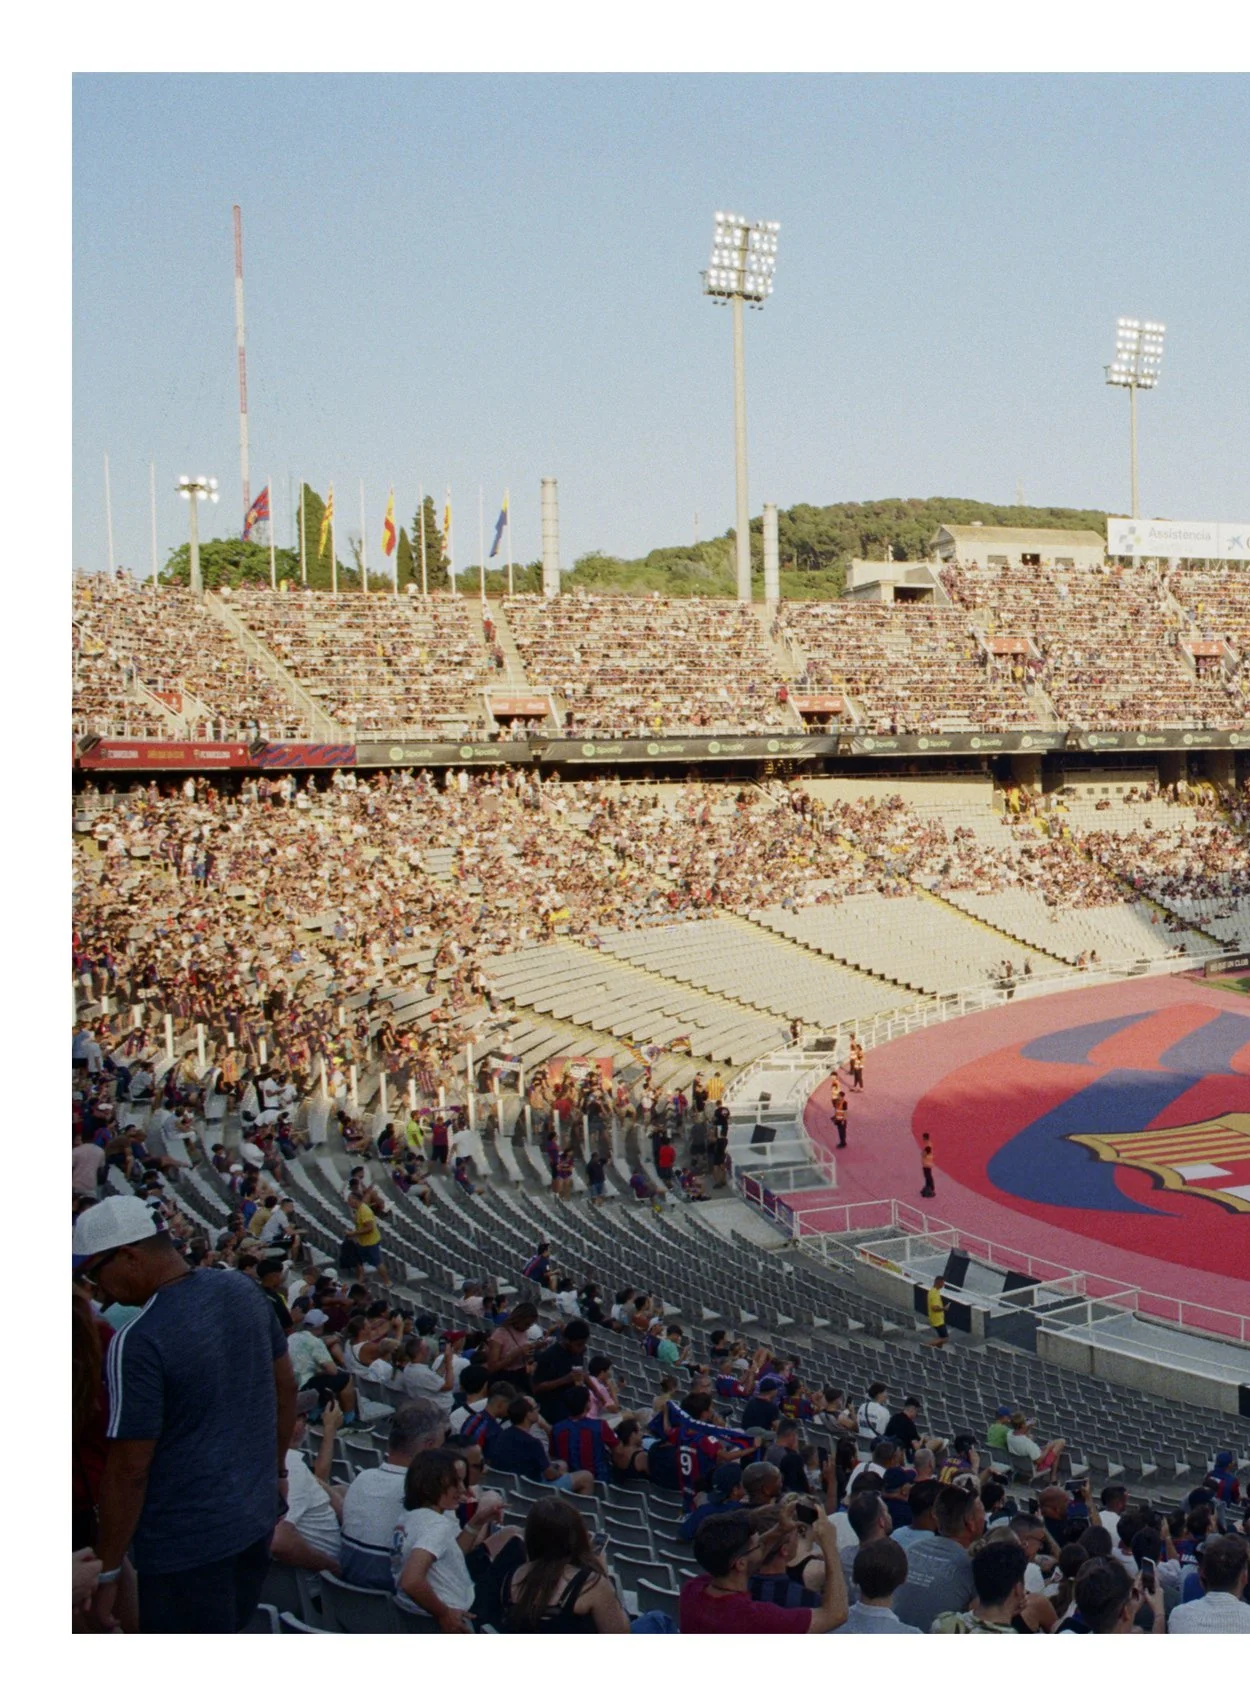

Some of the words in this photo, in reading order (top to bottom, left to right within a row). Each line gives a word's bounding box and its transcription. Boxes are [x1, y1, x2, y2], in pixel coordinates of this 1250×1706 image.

[405, 749, 433, 758] Spotify
[474, 748, 500, 757] Spotify
[596, 745, 623, 754] Spotify
[680, 1453, 692, 1475] 9
